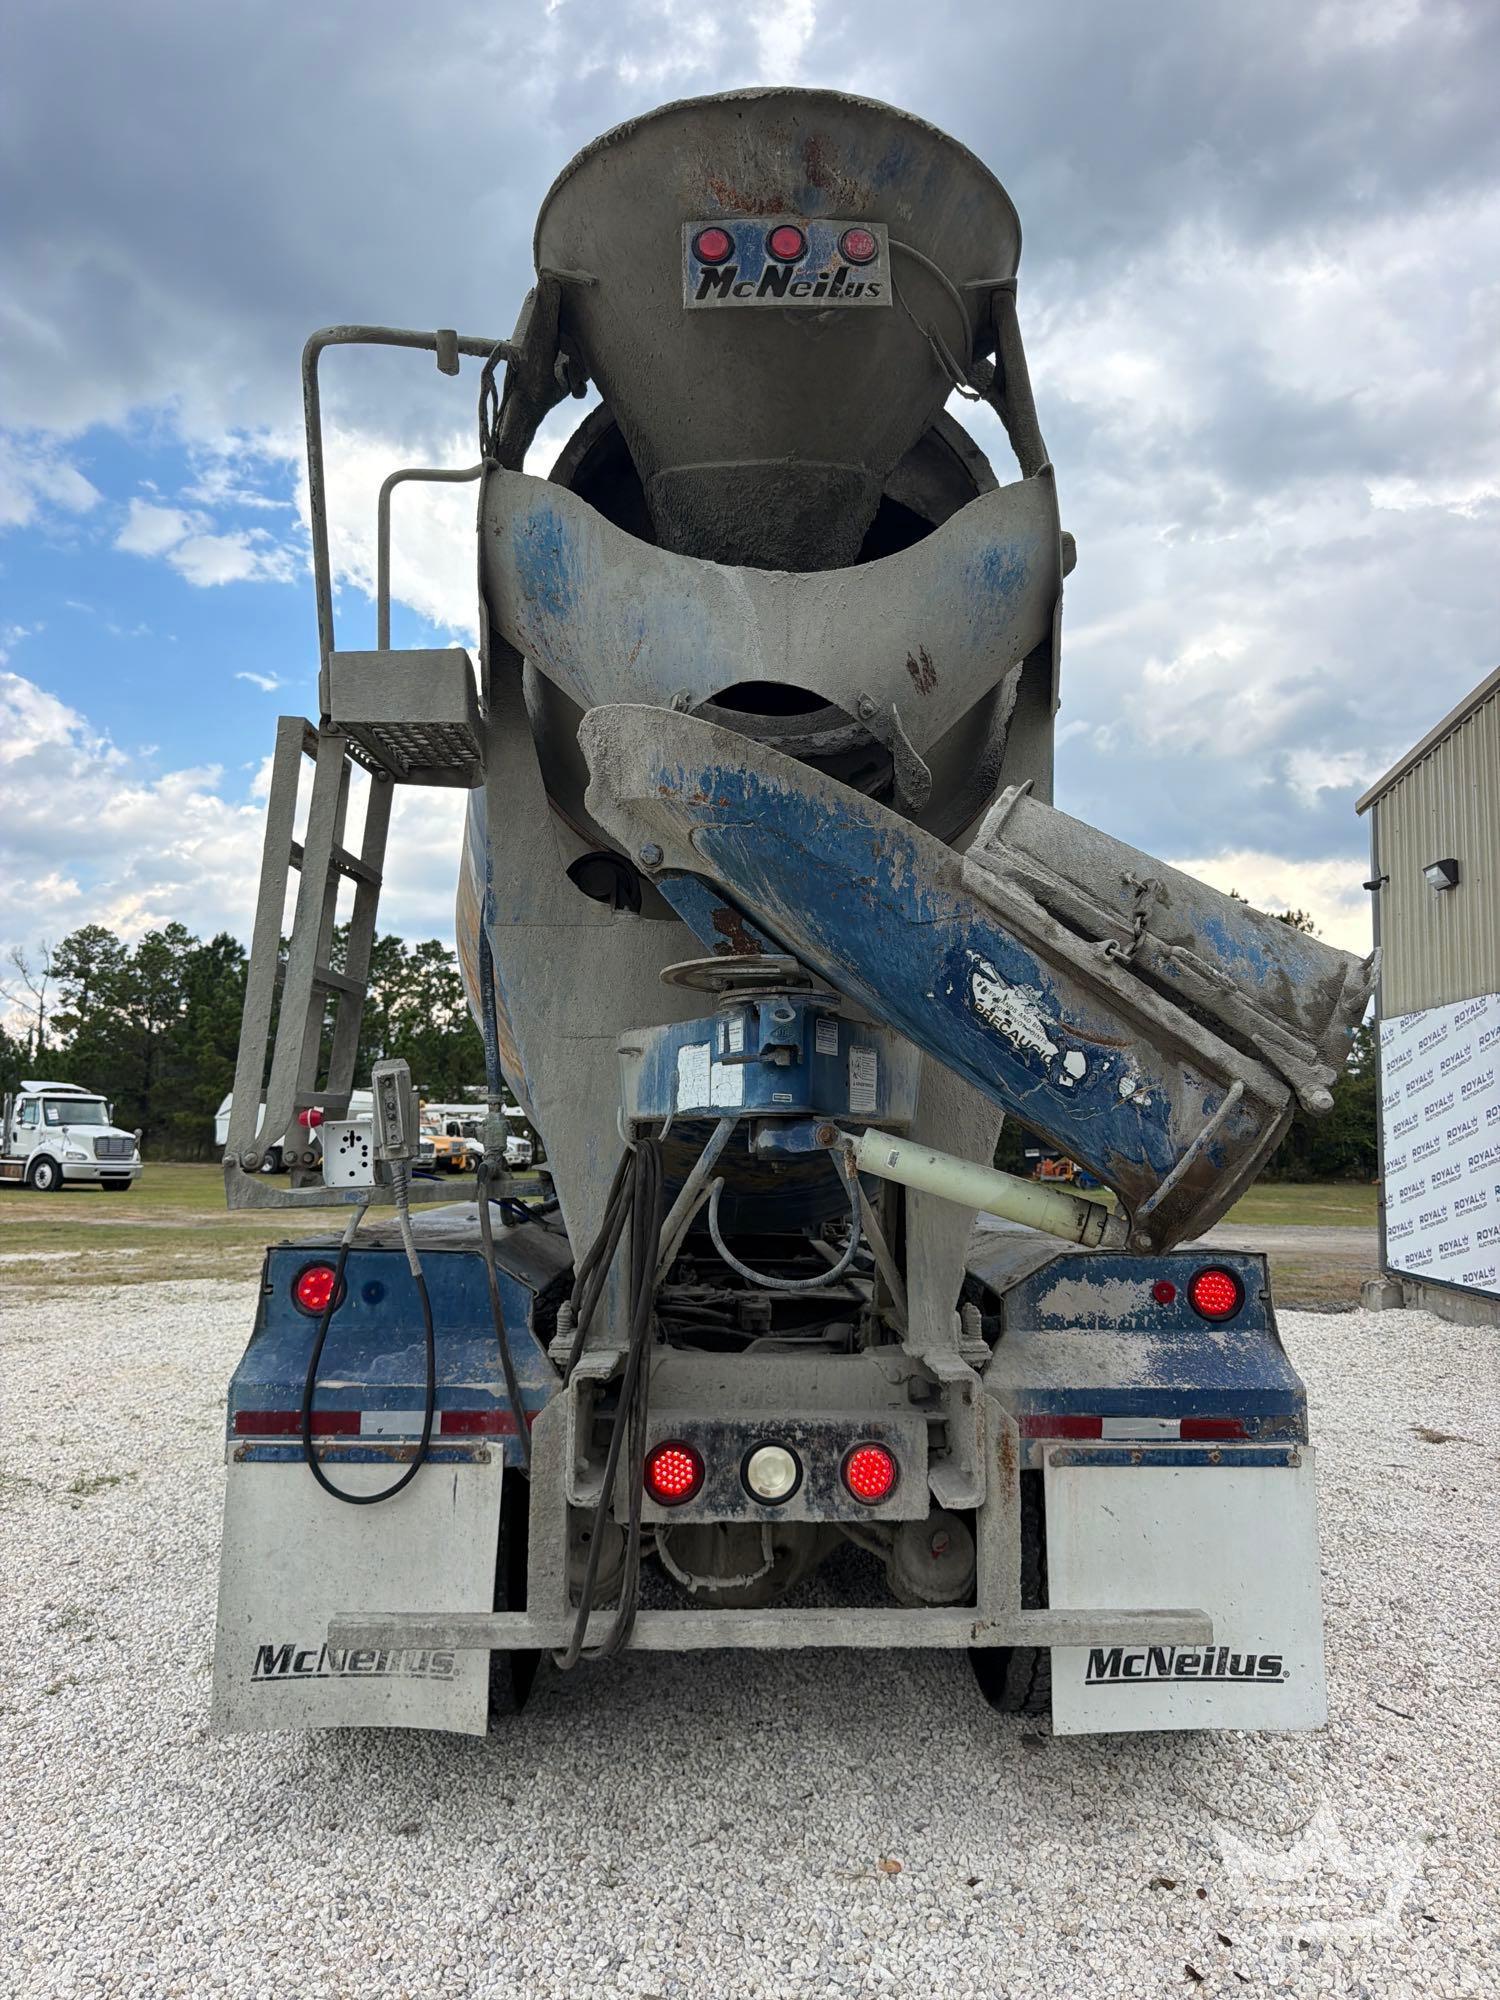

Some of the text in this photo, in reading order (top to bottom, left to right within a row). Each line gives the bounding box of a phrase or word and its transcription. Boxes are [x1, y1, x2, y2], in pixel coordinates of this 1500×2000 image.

[695, 264, 882, 300] McNeilus
[1455, 1002, 1480, 1024] ROYAL
[1017, 1011, 1032, 1024] AND
[1031, 1021, 1045, 1034] BOD
[1024, 1025, 1049, 1046] OINTS
[1419, 1029, 1442, 1050] ROYAL
[1478, 1025, 1500, 1047] ROYA
[1386, 1052, 1407, 1071] ROYAL
[1440, 1050, 1464, 1070] ROYAL
[1406, 1074, 1427, 1092] ROYAL
[1461, 1074, 1488, 1095] ROYAL
[1383, 1094, 1397, 1105] YAL
[1424, 1096, 1447, 1116] ROYAL
[1393, 1117, 1413, 1134] ROYAL
[1447, 1120, 1471, 1139] ROYAL
[1412, 1140, 1434, 1157] ROYAL
[1386, 1158, 1401, 1170] OYAL
[1468, 1149, 1494, 1166] ROYAL
[1432, 1166, 1454, 1183] ROYAL
[1400, 1184, 1419, 1198] ROYAL
[1454, 1194, 1479, 1210] ROYAL
[1420, 1210, 1440, 1224] ROYAL
[1388, 1222, 1408, 1235] ROYAL
[1477, 1225, 1500, 1240] ROYA
[1439, 1238, 1462, 1252] ROYAL
[1406, 1251, 1426, 1263] ROYAL
[1463, 1270, 1488, 1283] ROYAL
